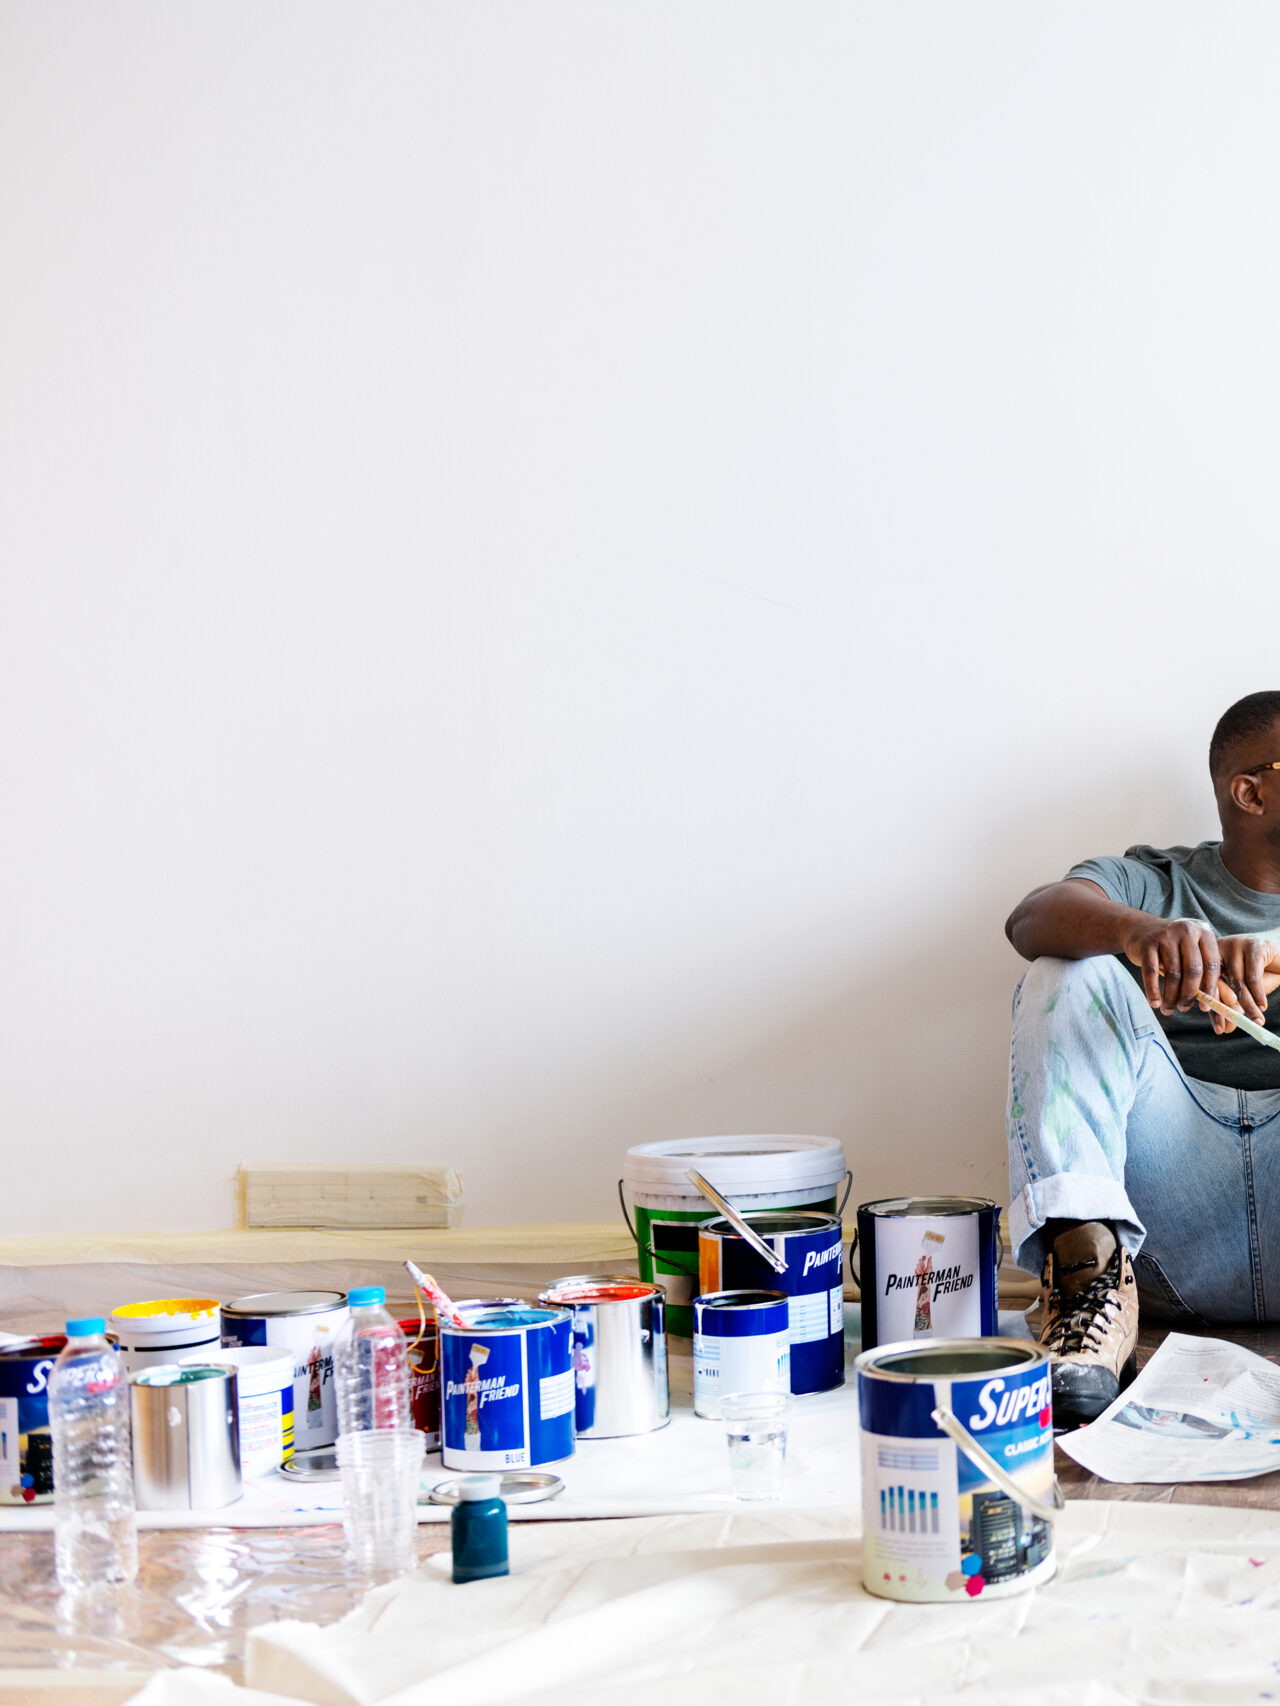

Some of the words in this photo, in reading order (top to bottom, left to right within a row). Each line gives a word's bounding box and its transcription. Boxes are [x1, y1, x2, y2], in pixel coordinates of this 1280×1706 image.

[885, 1265, 961, 1296] PAINTERMAN
[933, 1274, 973, 1302] FRIEND
[446, 1375, 506, 1400] PAINTERMAN
[479, 1384, 520, 1408] FRIEND
[505, 1452, 526, 1464] BLUE
